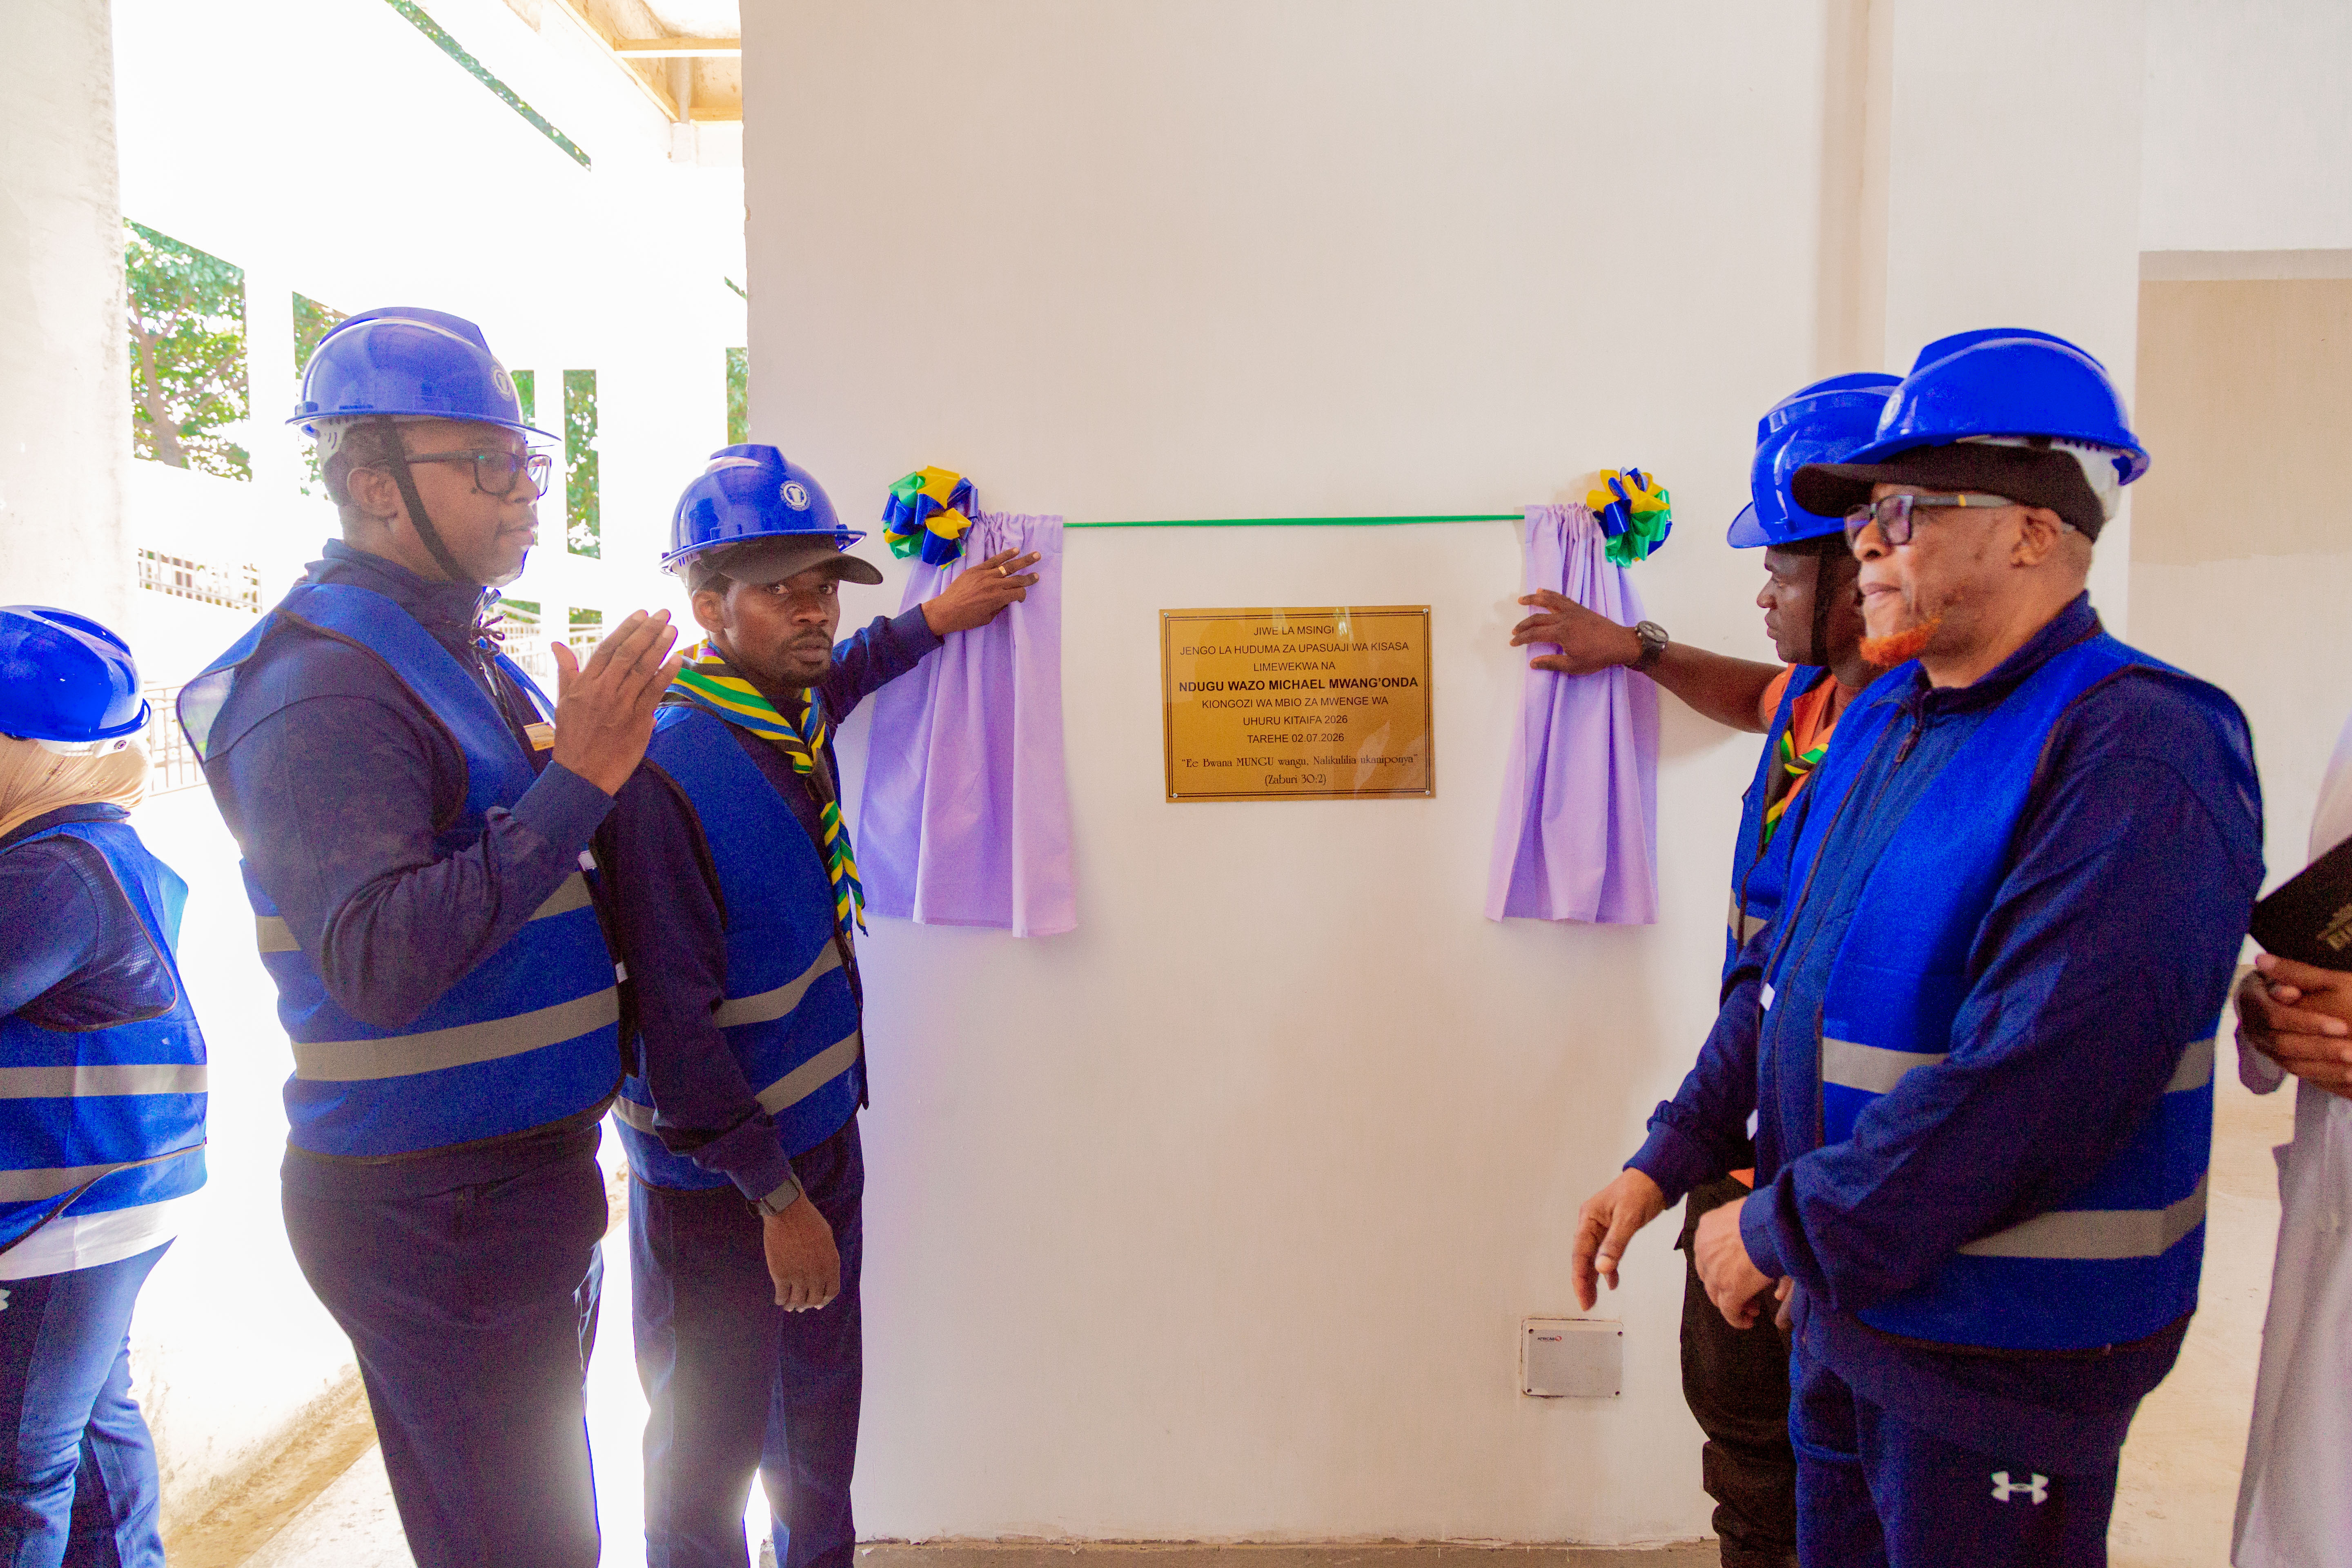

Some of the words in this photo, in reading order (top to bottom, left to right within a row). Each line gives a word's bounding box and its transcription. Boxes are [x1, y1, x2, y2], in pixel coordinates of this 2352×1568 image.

[1254, 627, 1278, 635] JIWE
[1282, 626, 1295, 635] LA
[1297, 626, 1334, 634] MSINGI
[1180, 646, 1216, 655] JENGO
[1219, 646, 1232, 654] LA
[1234, 645, 1280, 654] HUDUMA
[1283, 644, 1296, 653] ZA
[1299, 643, 1348, 652] UPASUAJI
[1352, 643, 1368, 651] WA
[1371, 641, 1409, 650] KISASA
[1254, 662, 1319, 671] LIMEWEKWA
[1321, 662, 1336, 670] NA
[1179, 682, 1224, 692] NDUGU
[1228, 680, 1265, 690] WAZO
[1269, 679, 1325, 690] MICHAEL
[1202, 699, 1252, 708] KIONGOZI
[1256, 699, 1272, 707] WA
[1275, 698, 1301, 707] MBIO
[1305, 698, 1318, 706] ZA
[1321, 697, 1369, 706] MWENGE
[1372, 696, 1388, 705] WA
[1243, 717, 1281, 725] UHURU
[1284, 715, 1322, 724] KITAIFA
[1325, 715, 1348, 724] 2026
[1247, 735, 1289, 743] TAREHE
[1292, 733, 1344, 742] 02.07.2026
[1203, 758, 1232, 767] Bwana
[1236, 757, 1274, 766] MUNGU
[1278, 758, 1309, 768] wangu,
[1313, 755, 1356, 765] Nalikulilia
[1265, 775, 1297, 786] (Zaburi
[1301, 774, 1326, 786] 30:2)
